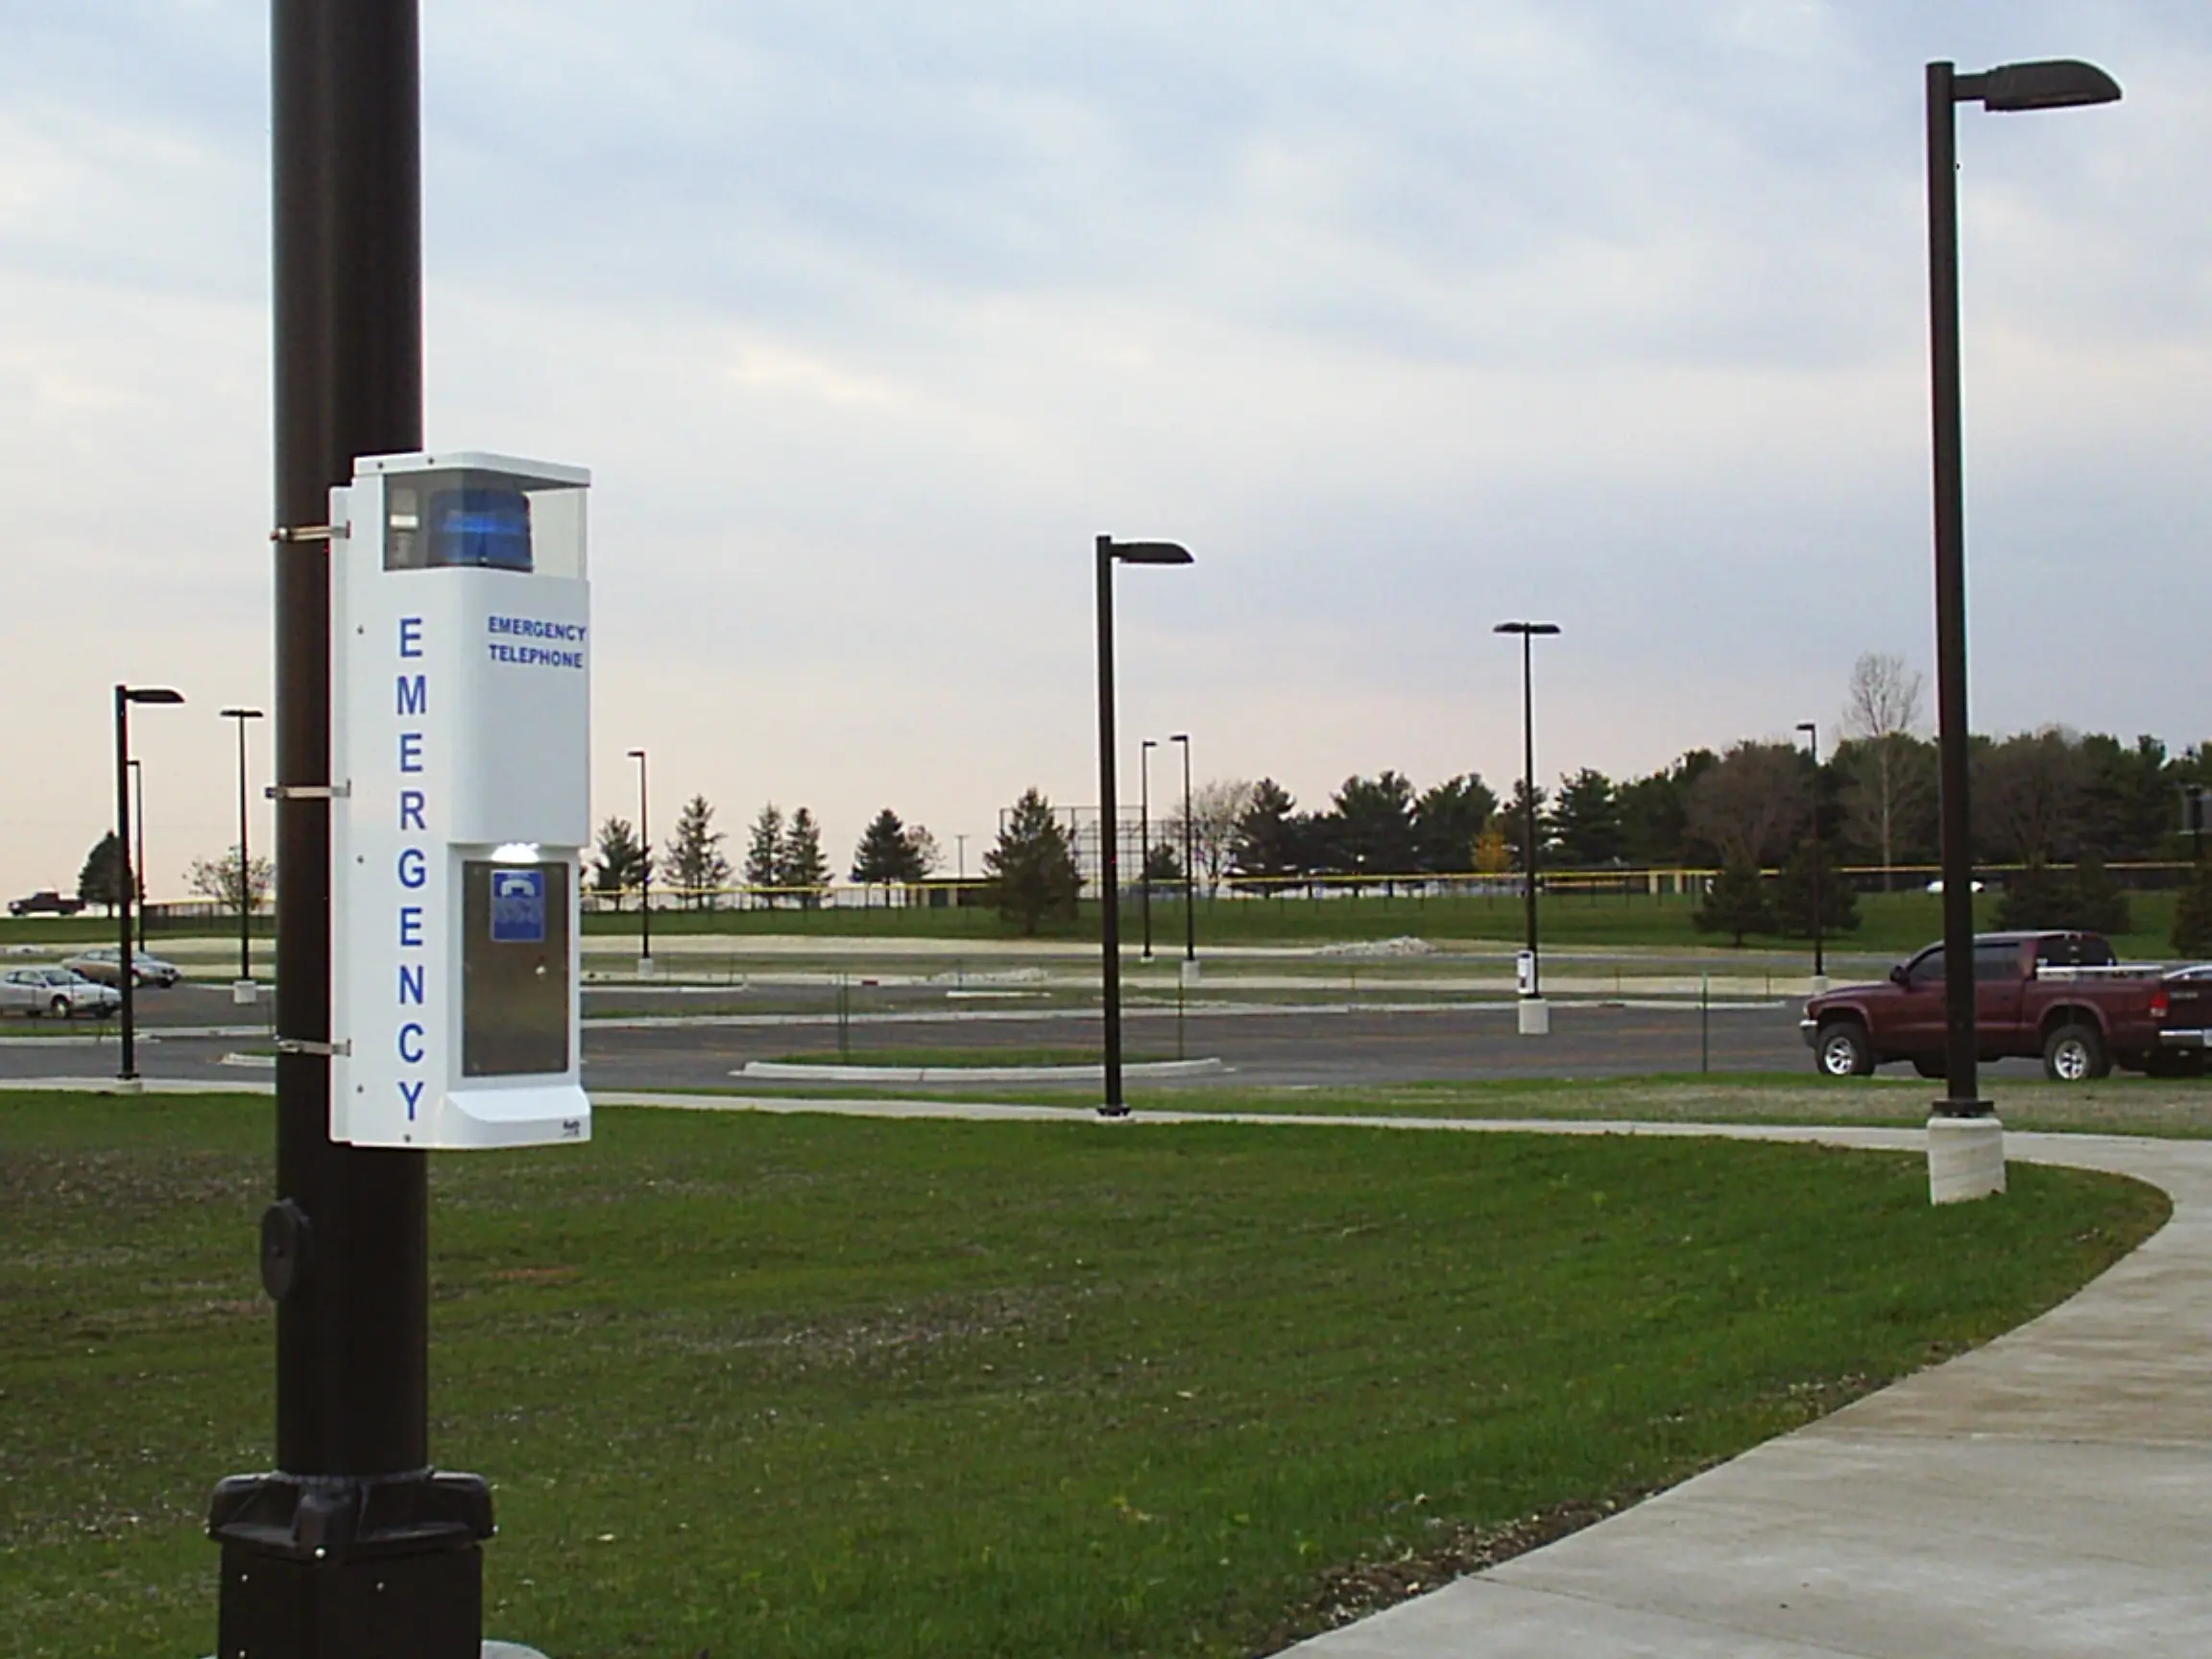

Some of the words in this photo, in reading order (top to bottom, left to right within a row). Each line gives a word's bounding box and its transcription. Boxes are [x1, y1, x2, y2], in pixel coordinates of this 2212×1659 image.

[488, 615, 587, 642] EMERGENCY
[489, 644, 584, 668] TELEPHONE
[396, 617, 427, 1121] EMERGENCY
